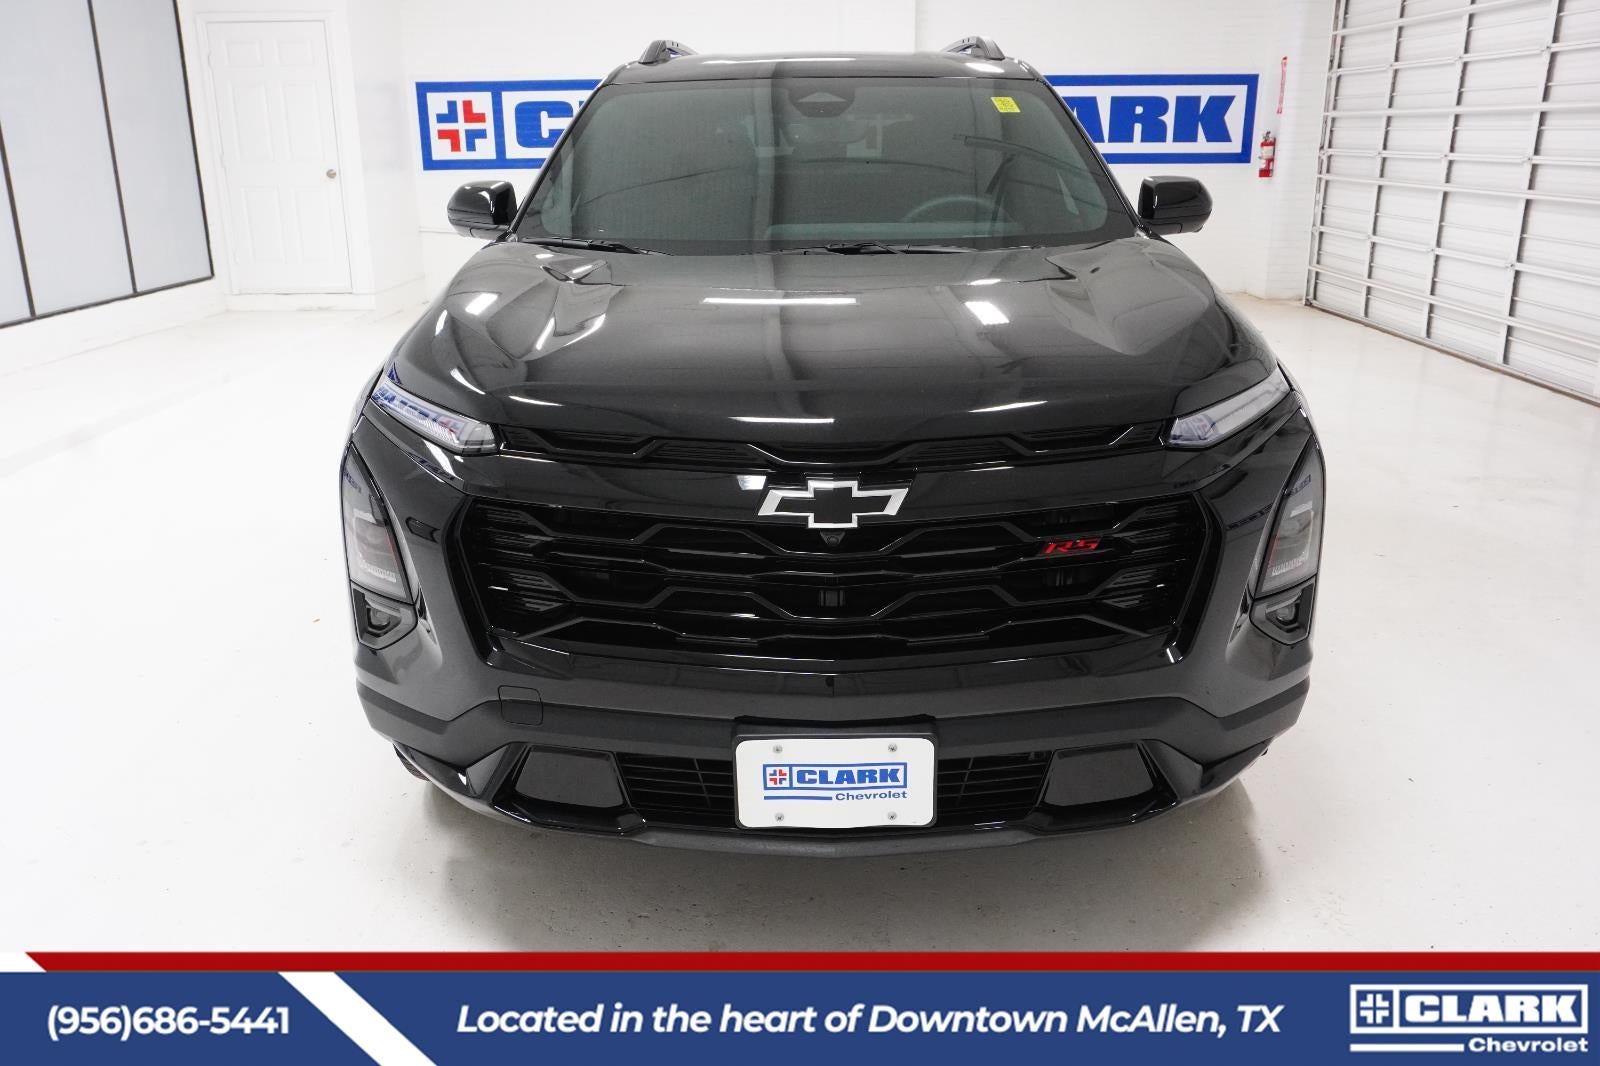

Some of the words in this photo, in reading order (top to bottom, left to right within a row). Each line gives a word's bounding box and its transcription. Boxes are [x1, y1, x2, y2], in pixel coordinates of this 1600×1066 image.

[1044, 536, 1103, 554] RS
[796, 768, 901, 785] CLARK
[835, 790, 908, 801] Chevrolet
